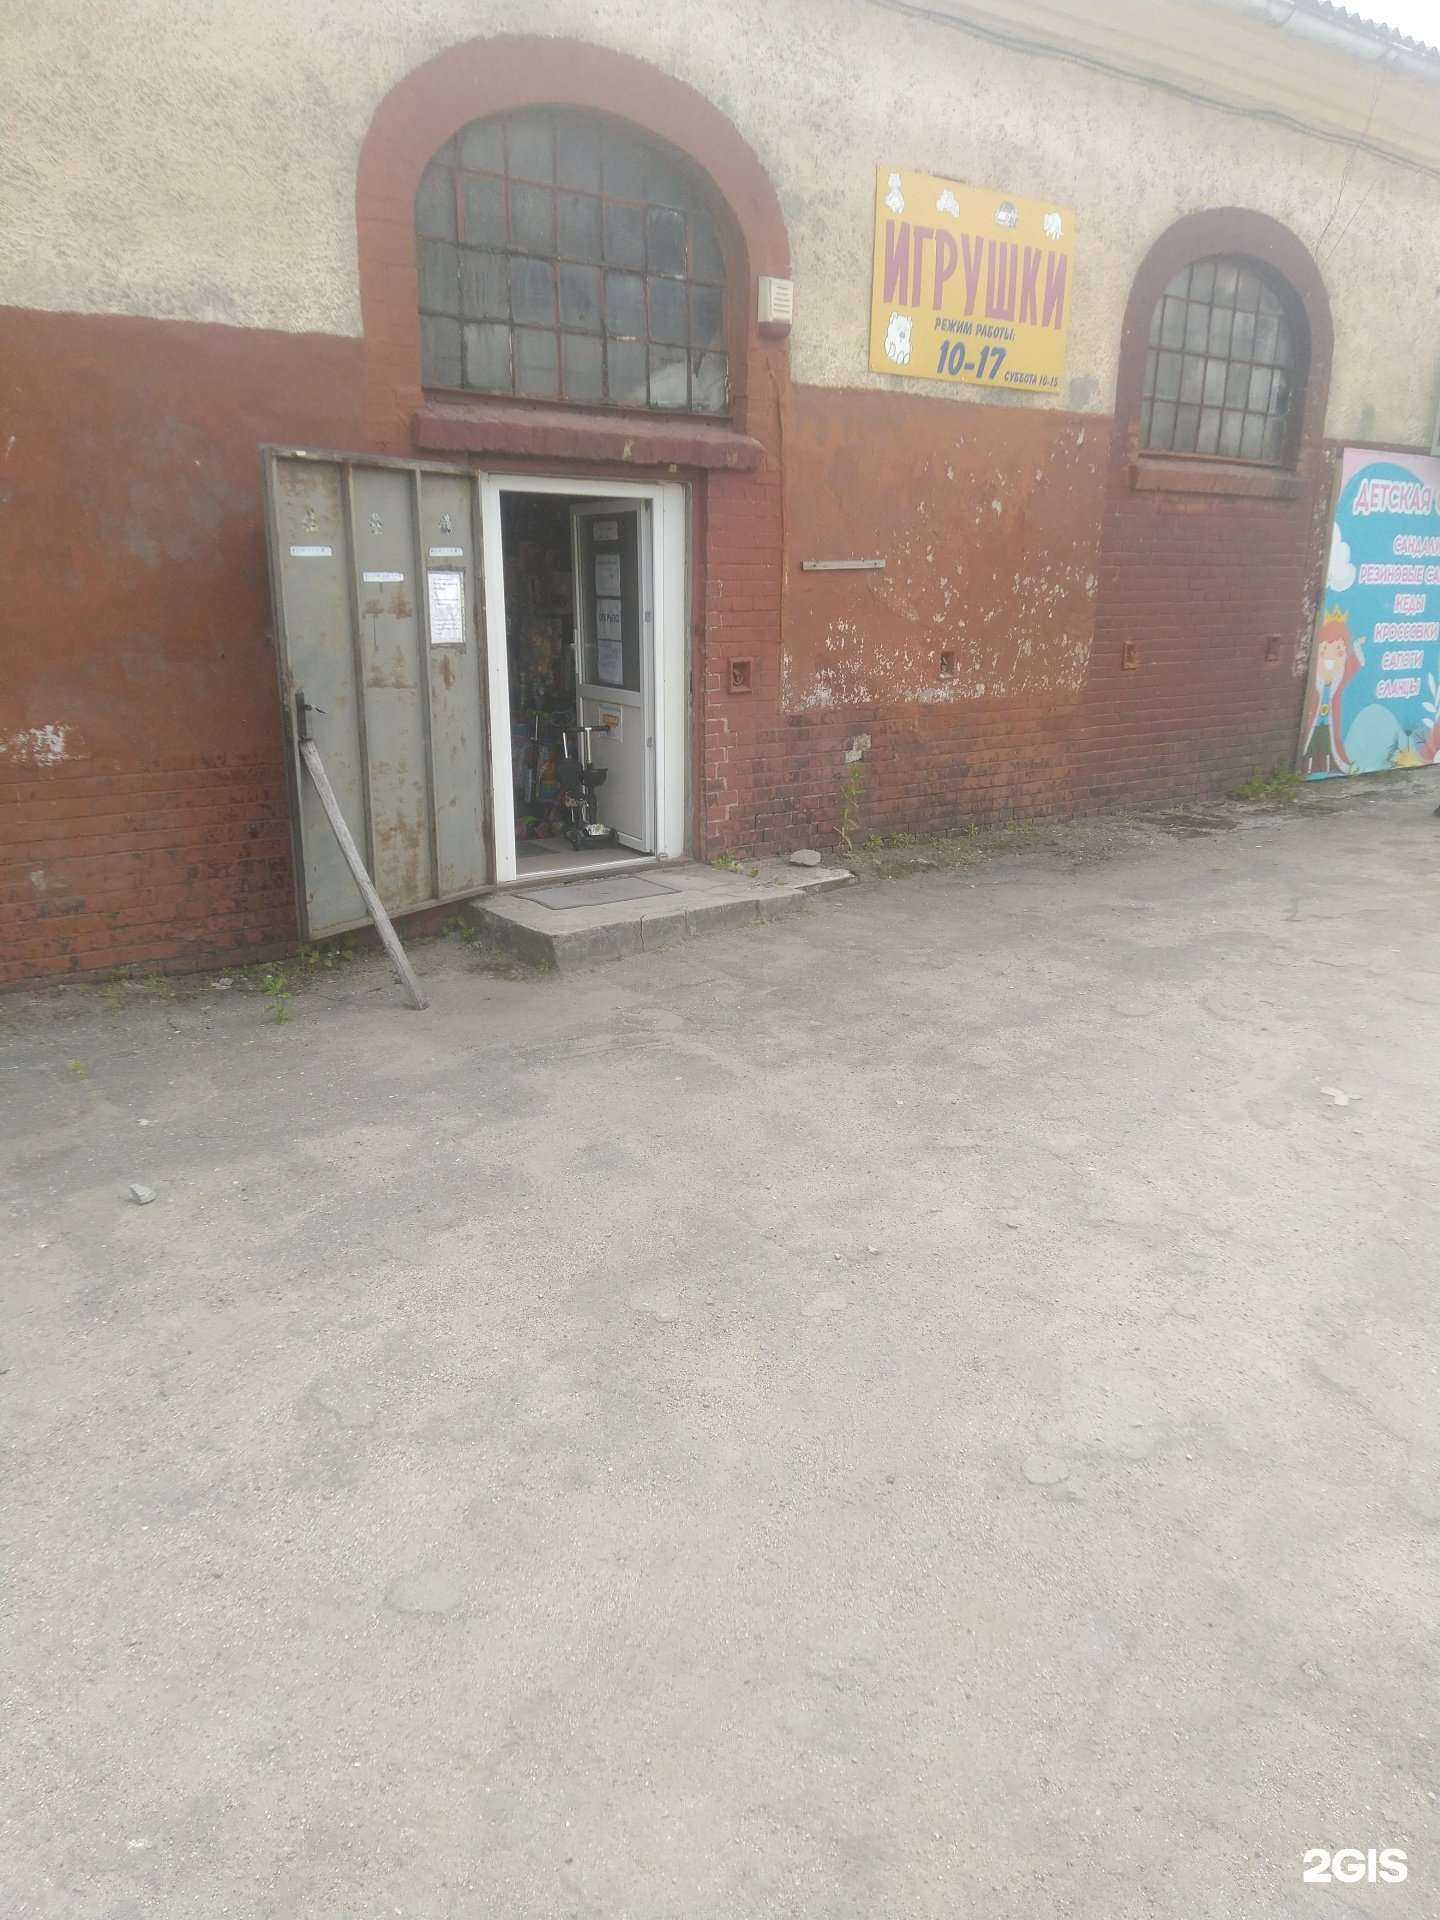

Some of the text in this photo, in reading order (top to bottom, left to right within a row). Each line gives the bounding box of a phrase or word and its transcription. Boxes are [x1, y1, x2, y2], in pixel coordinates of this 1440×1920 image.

[882, 218, 1068, 331] ИГРУШКИ
[934, 317, 973, 336] РЕЖИМ
[936, 340, 1007, 380] 10-17
[1004, 371, 1059, 388] СУББОТА 10-15
[1353, 479, 1433, 515] ДЕТСКАЯ
[1360, 565, 1424, 585] РЕЗИНОВЫЕ
[1394, 594, 1426, 615] КЕДЫ
[1374, 623, 1439, 642] КРОССОВКИ
